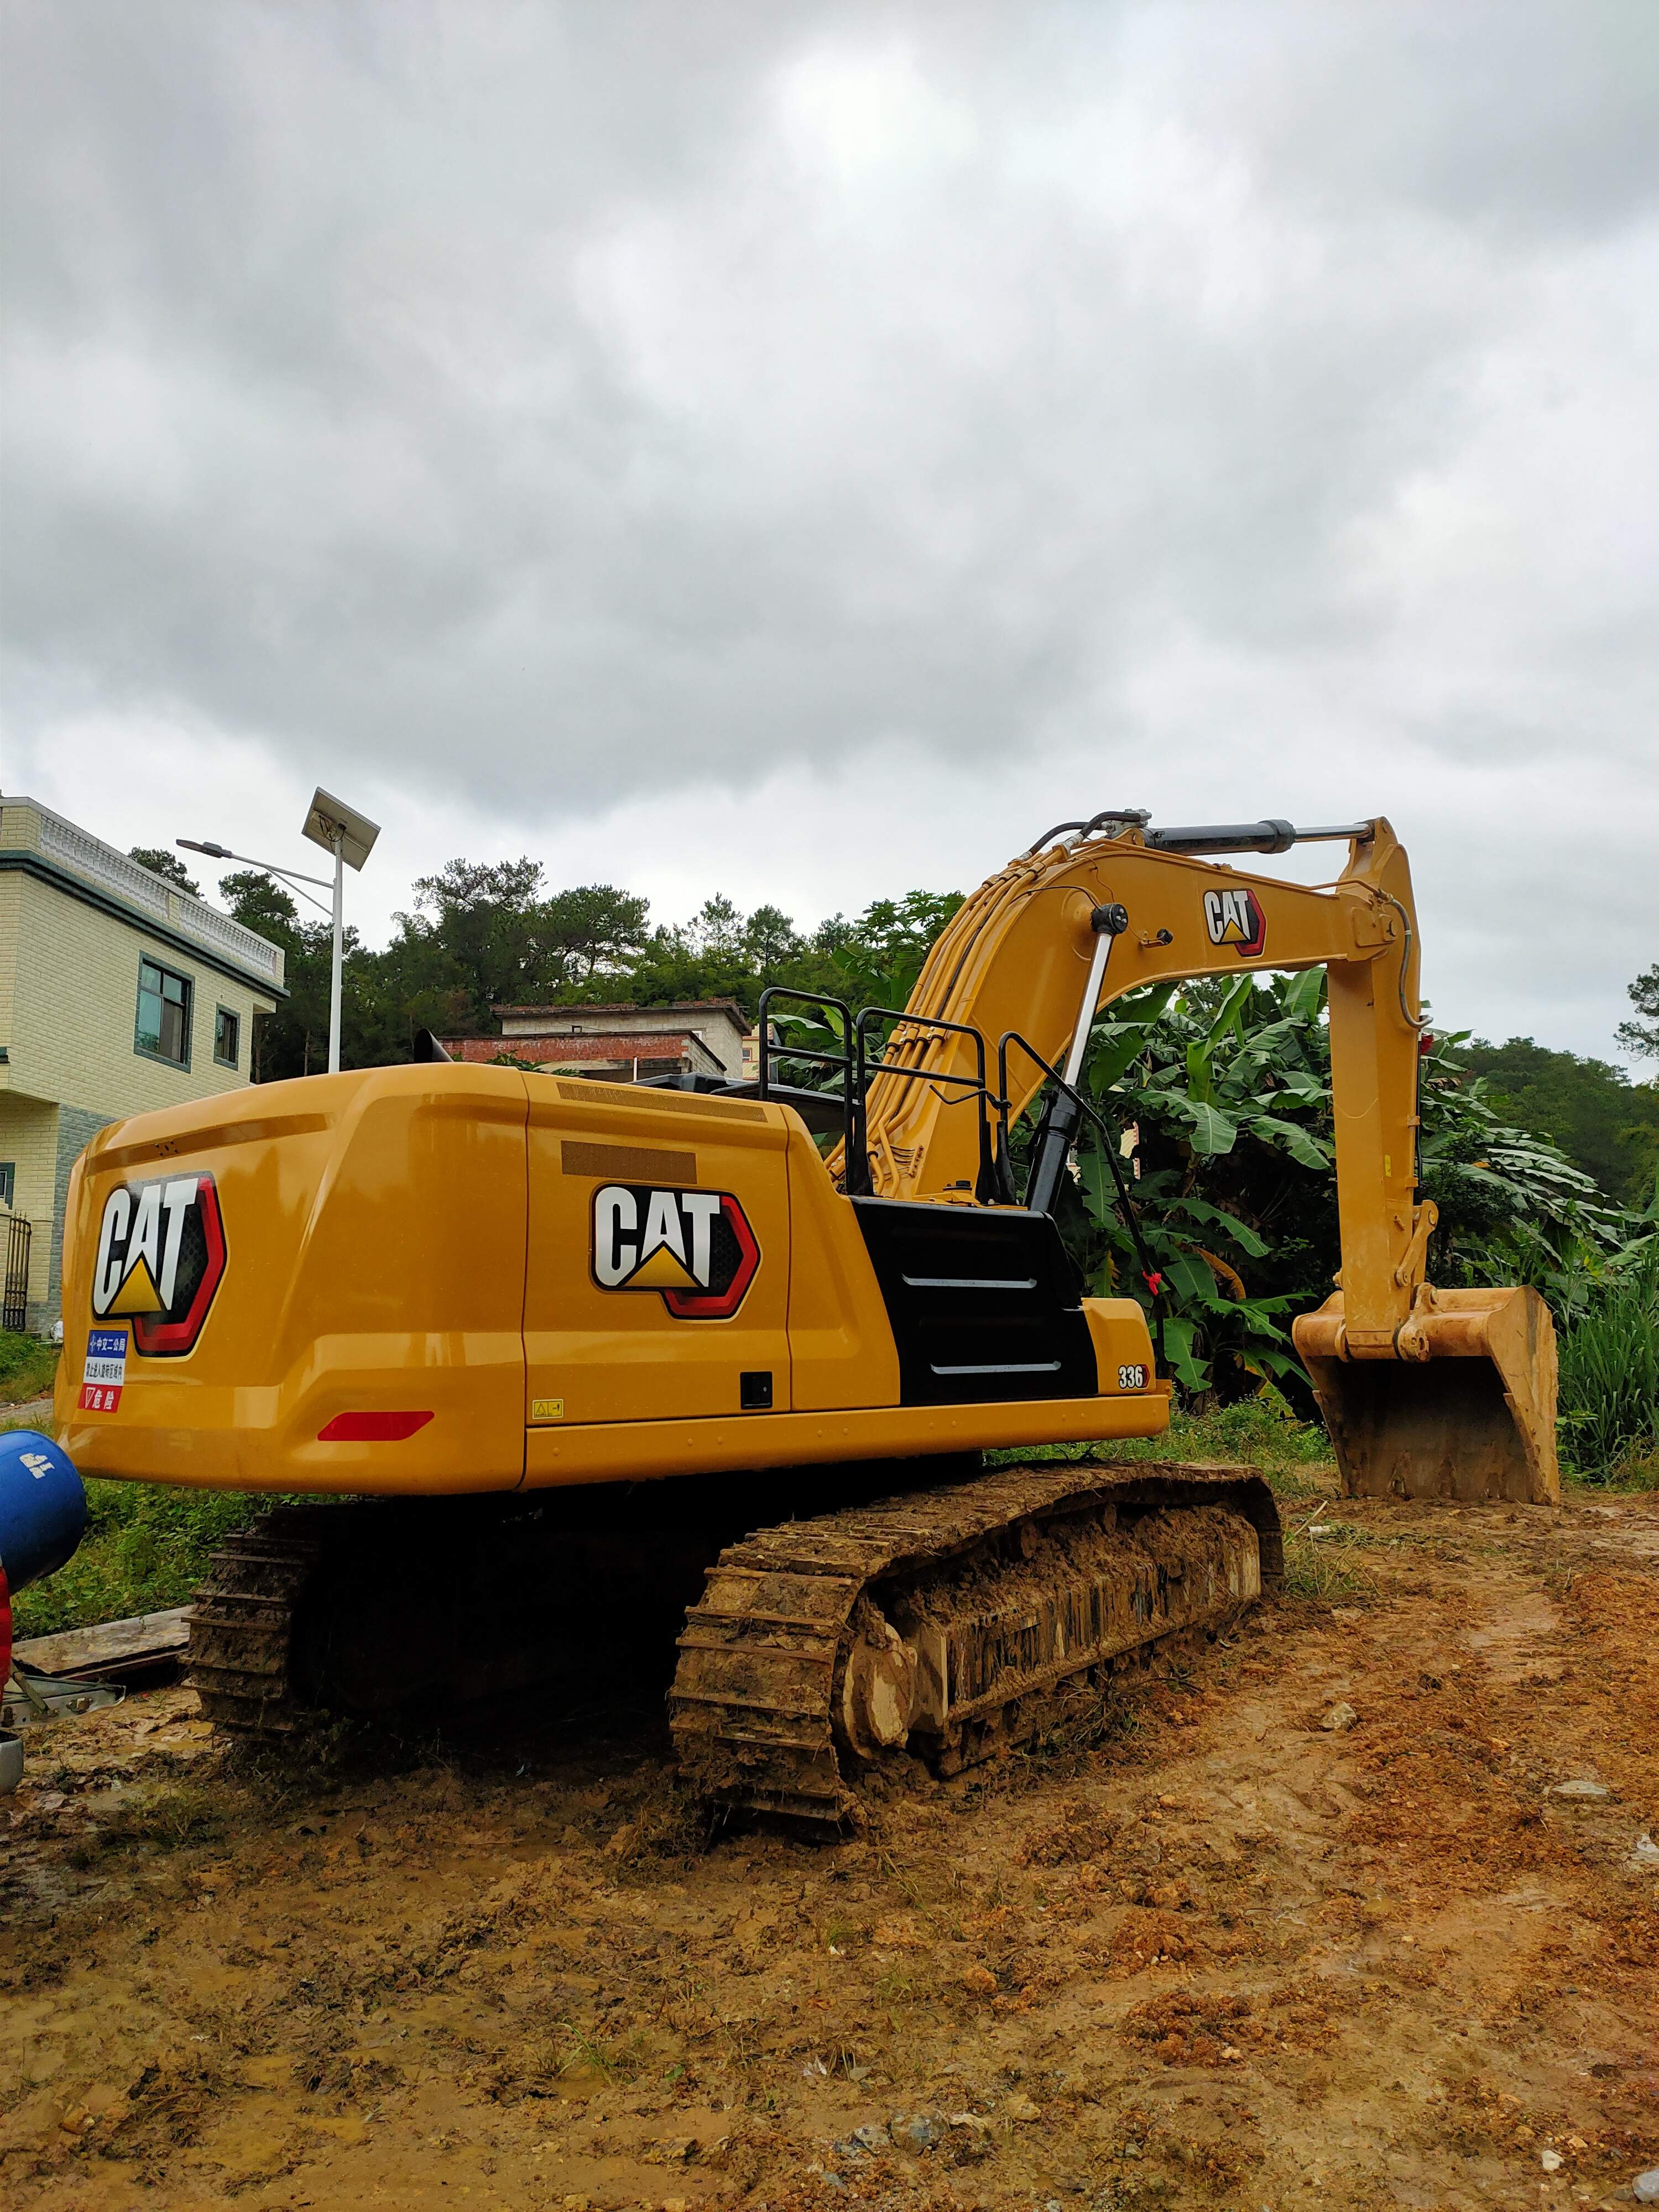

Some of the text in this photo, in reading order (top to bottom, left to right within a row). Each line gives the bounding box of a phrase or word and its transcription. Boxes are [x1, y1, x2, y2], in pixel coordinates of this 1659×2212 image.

[1204, 890, 1251, 942] CAT
[93, 1178, 199, 1314] CAT
[596, 1187, 720, 1287] CAT
[96, 1337, 126, 1352] 中交二公局
[1119, 1365, 1143, 1388] 336
[92, 1389, 114, 1410] 危险
